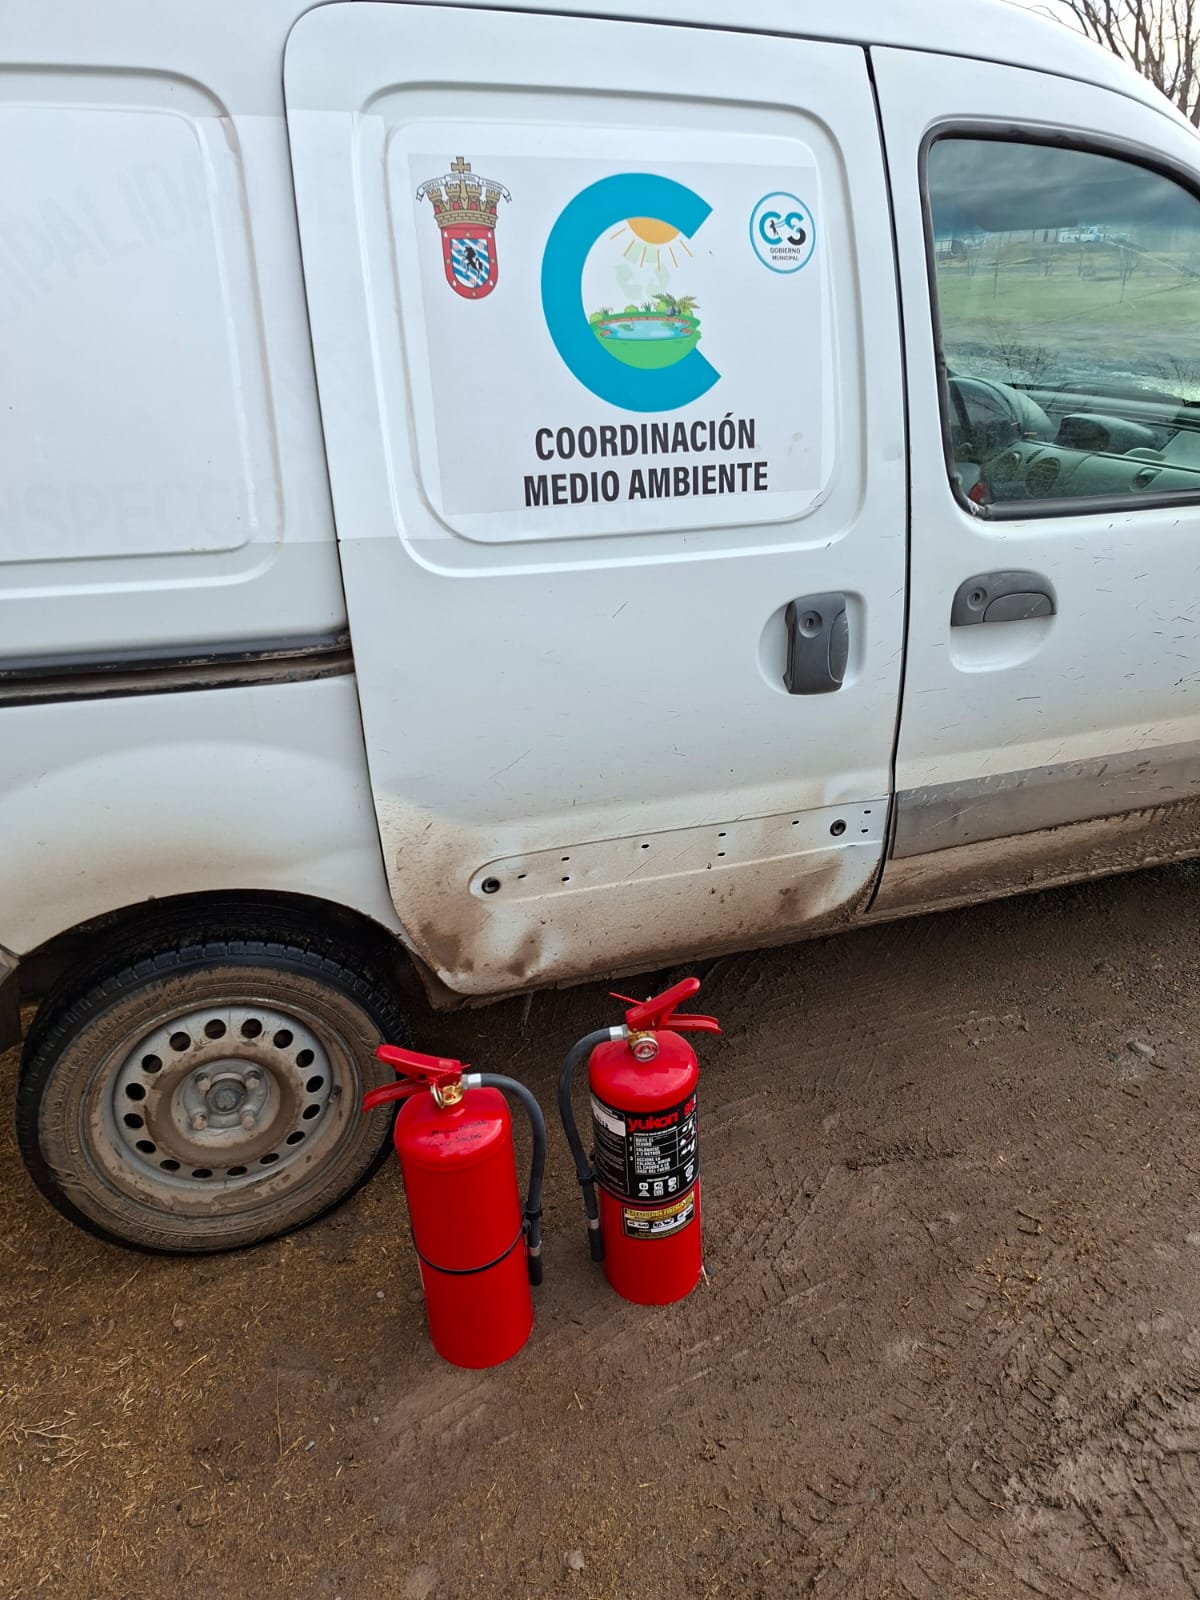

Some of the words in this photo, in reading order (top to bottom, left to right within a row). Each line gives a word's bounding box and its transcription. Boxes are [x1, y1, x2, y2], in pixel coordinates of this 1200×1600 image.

[535, 412, 756, 460] COORDINACIÓN
[524, 470, 620, 507] MEDIO
[628, 461, 768, 500] AMBIENTE
[627, 1112, 679, 1132] yukon
